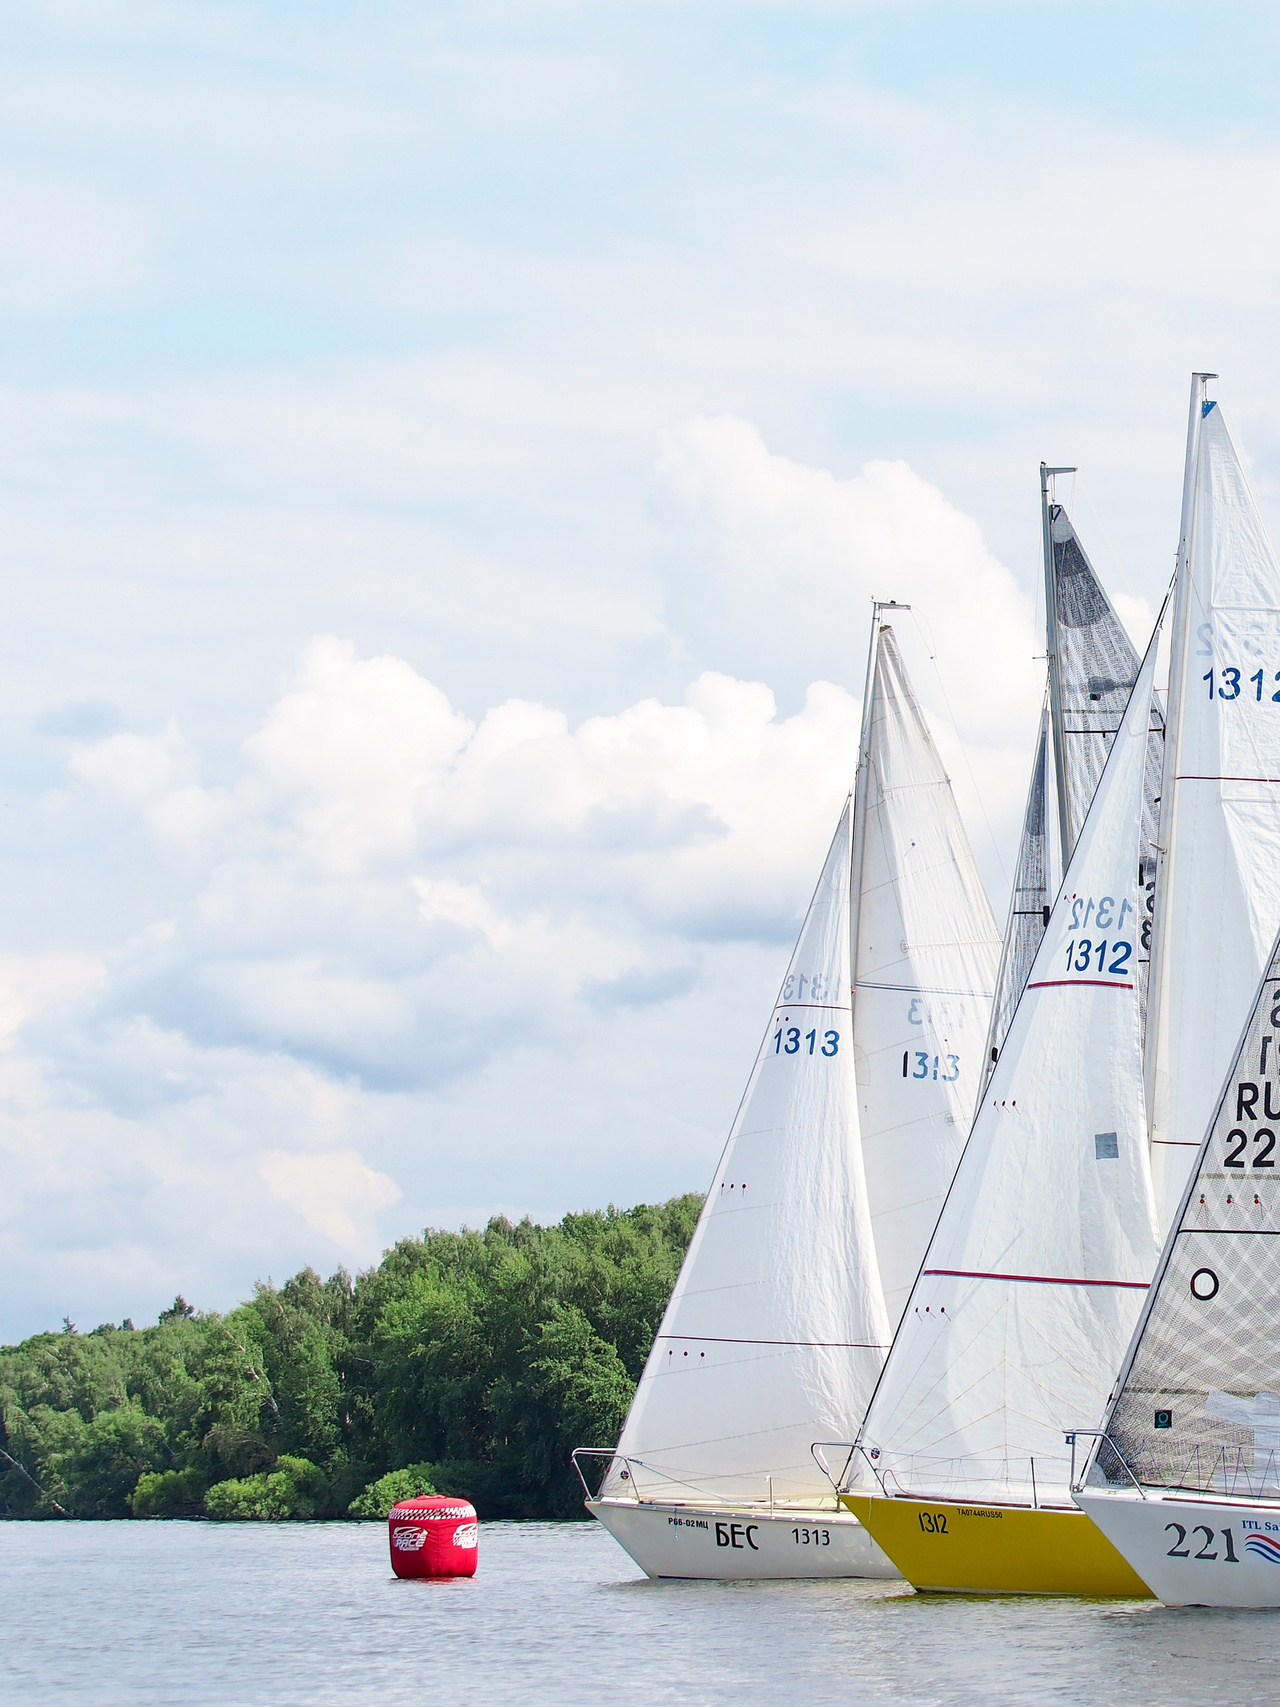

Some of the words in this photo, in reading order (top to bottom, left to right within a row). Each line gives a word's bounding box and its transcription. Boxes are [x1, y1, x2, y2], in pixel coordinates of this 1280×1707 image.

[1066, 939, 1132, 975] 1312
[774, 1027, 840, 1057] 1313
[902, 1050, 960, 1082] 1313
[715, 1522, 759, 1550] БЕС
[792, 1528, 831, 1546] 1313
[918, 1512, 949, 1534] 1312
[1241, 1519, 1262, 1530] ITL
[1164, 1522, 1240, 1563] 221
